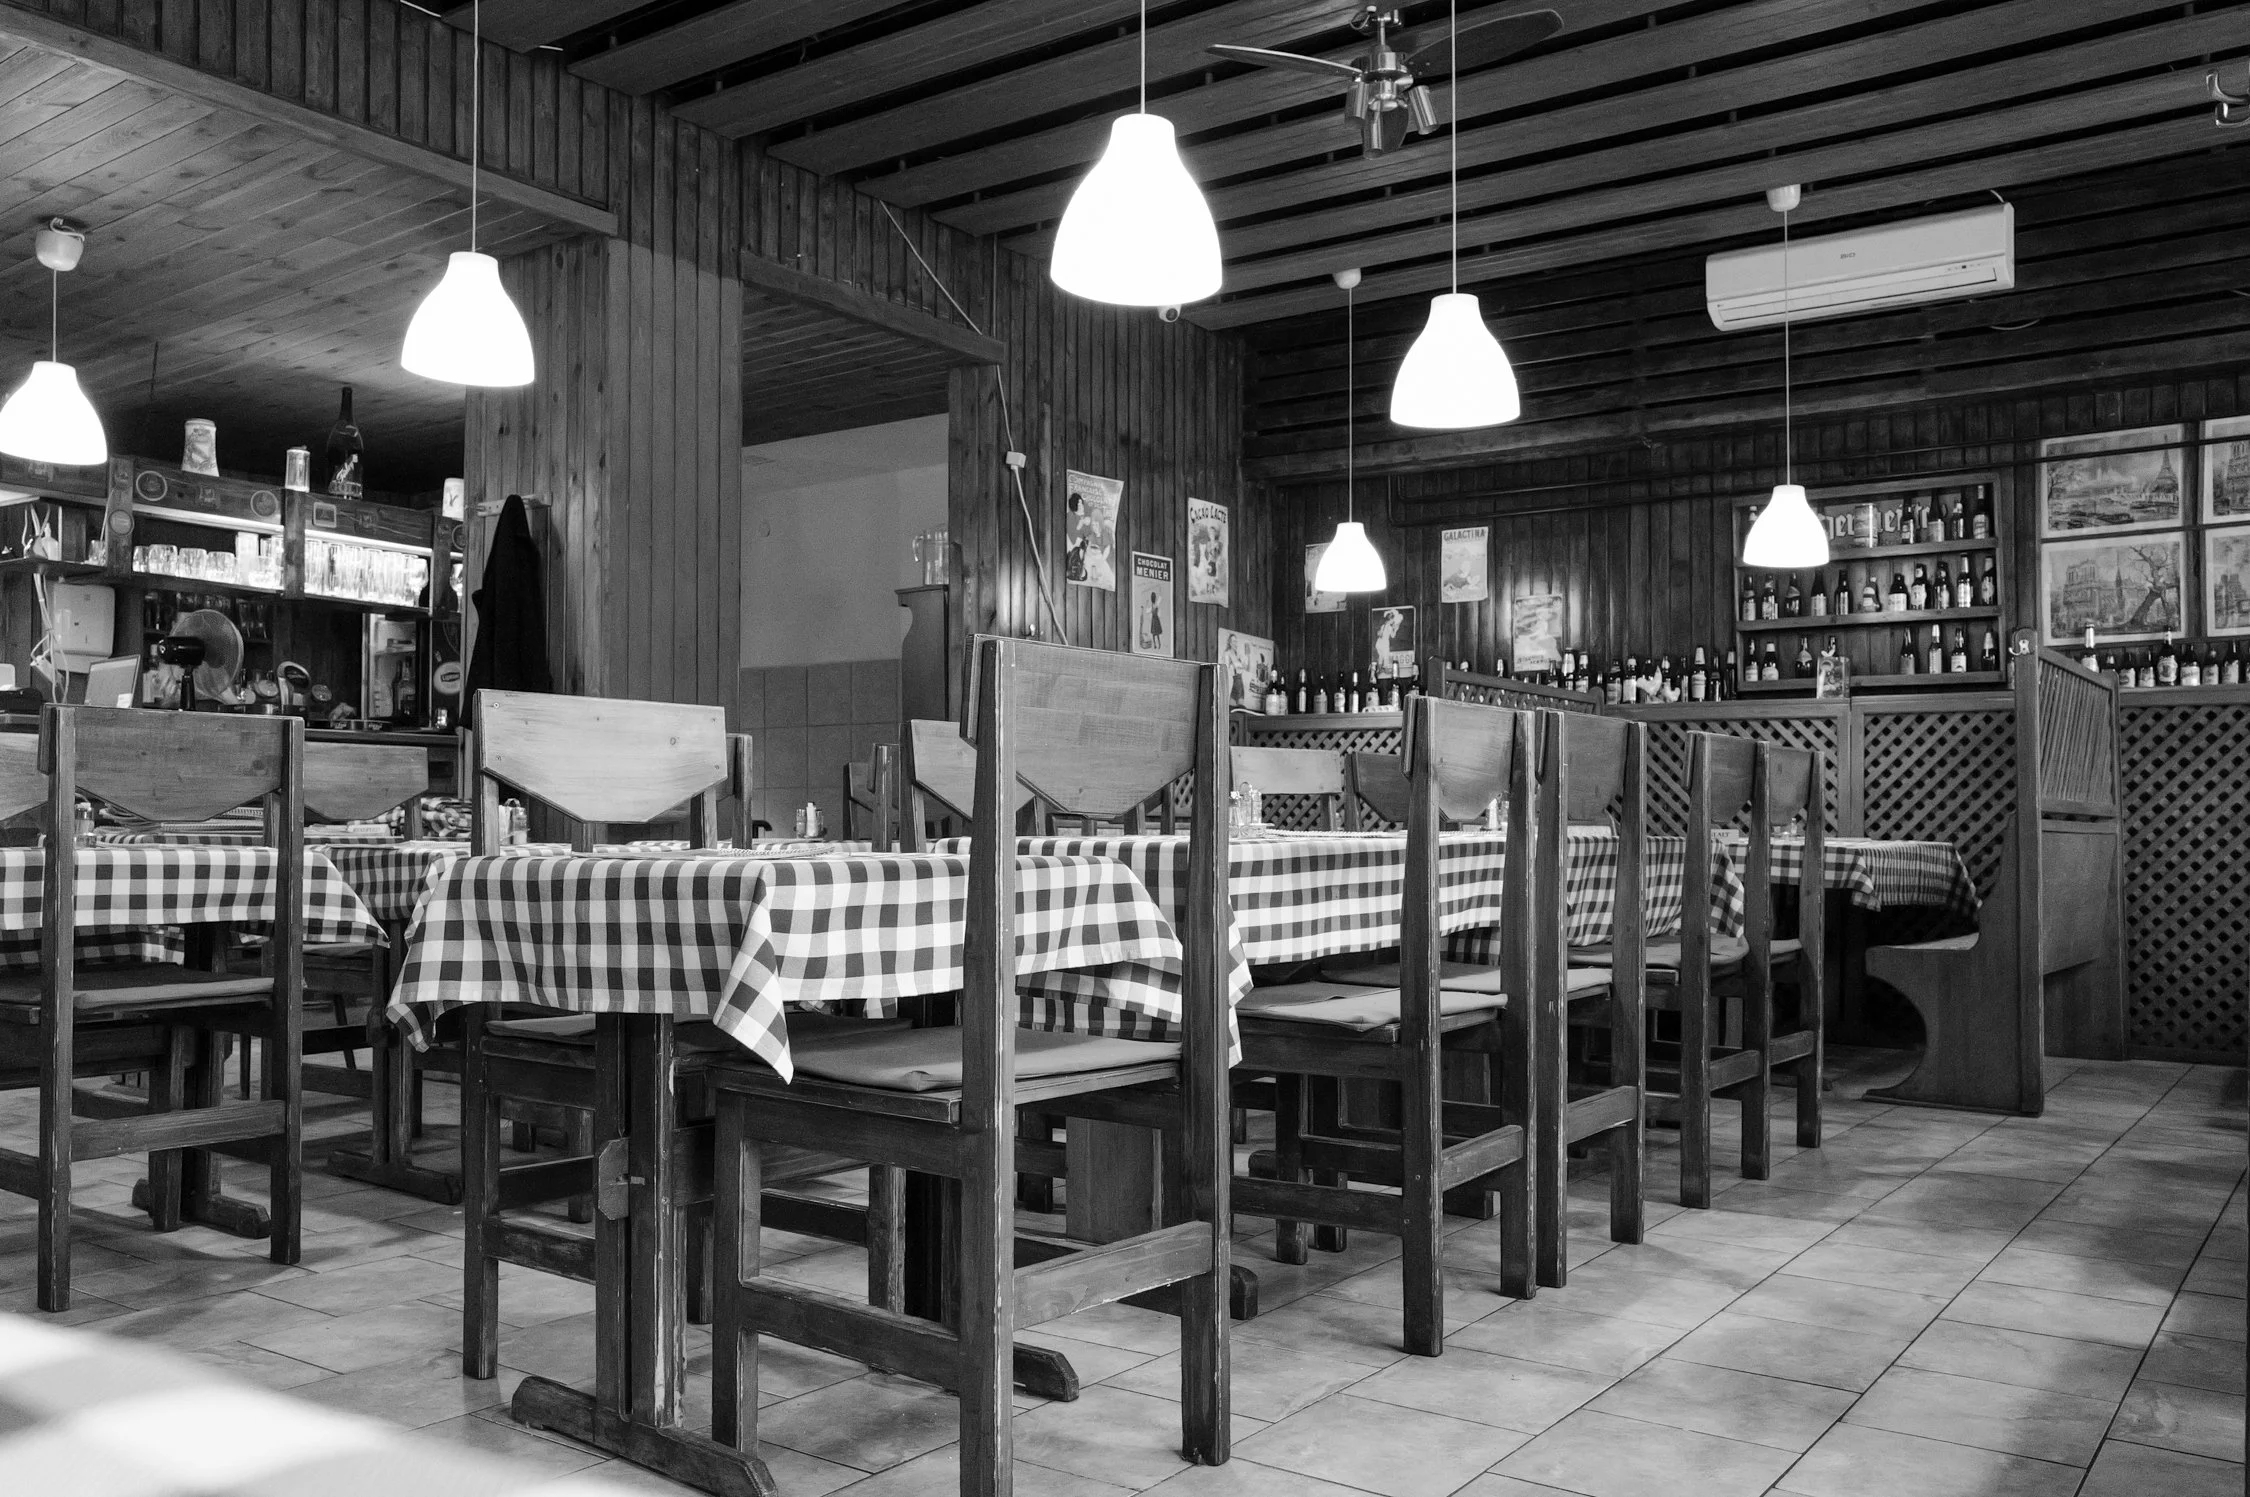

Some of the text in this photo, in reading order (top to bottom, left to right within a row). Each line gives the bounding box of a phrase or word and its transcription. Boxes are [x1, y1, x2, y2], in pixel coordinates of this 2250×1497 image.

[1443, 528, 1485, 542] GALACTINA
[1137, 557, 1168, 570] CHOCOLAT
[1136, 566, 1169, 581] MENIER
